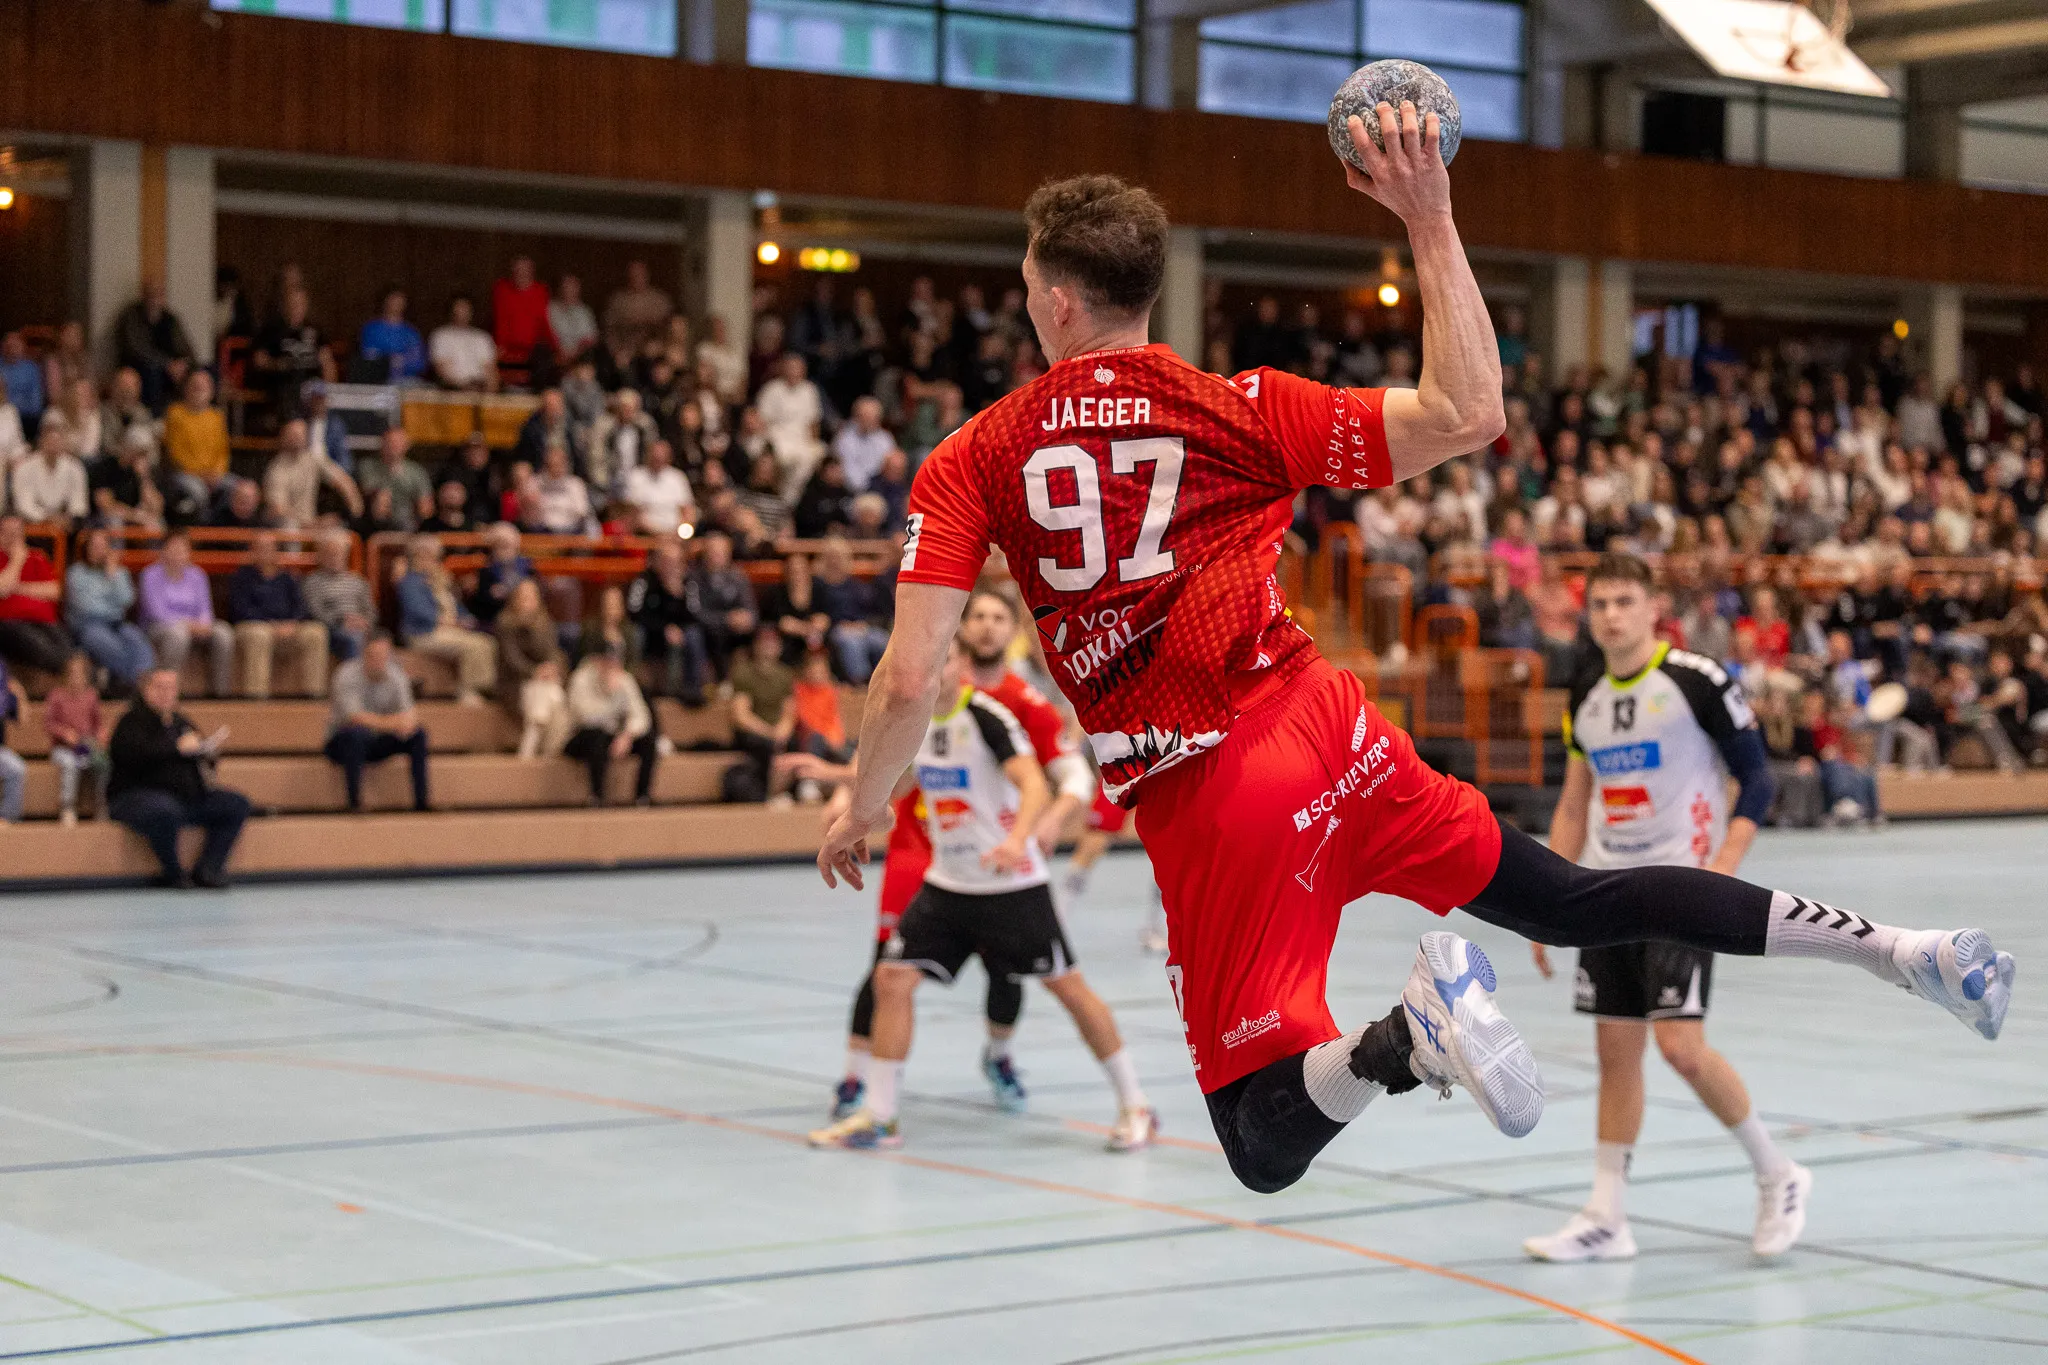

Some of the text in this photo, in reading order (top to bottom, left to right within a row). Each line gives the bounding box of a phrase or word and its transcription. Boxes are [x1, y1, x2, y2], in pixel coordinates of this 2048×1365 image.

[1042, 397, 1151, 431] JAEGER
[1349, 417, 1369, 490] RAABE
[1021, 436, 1185, 592] 97
[1248, 1009, 1280, 1030] foods
